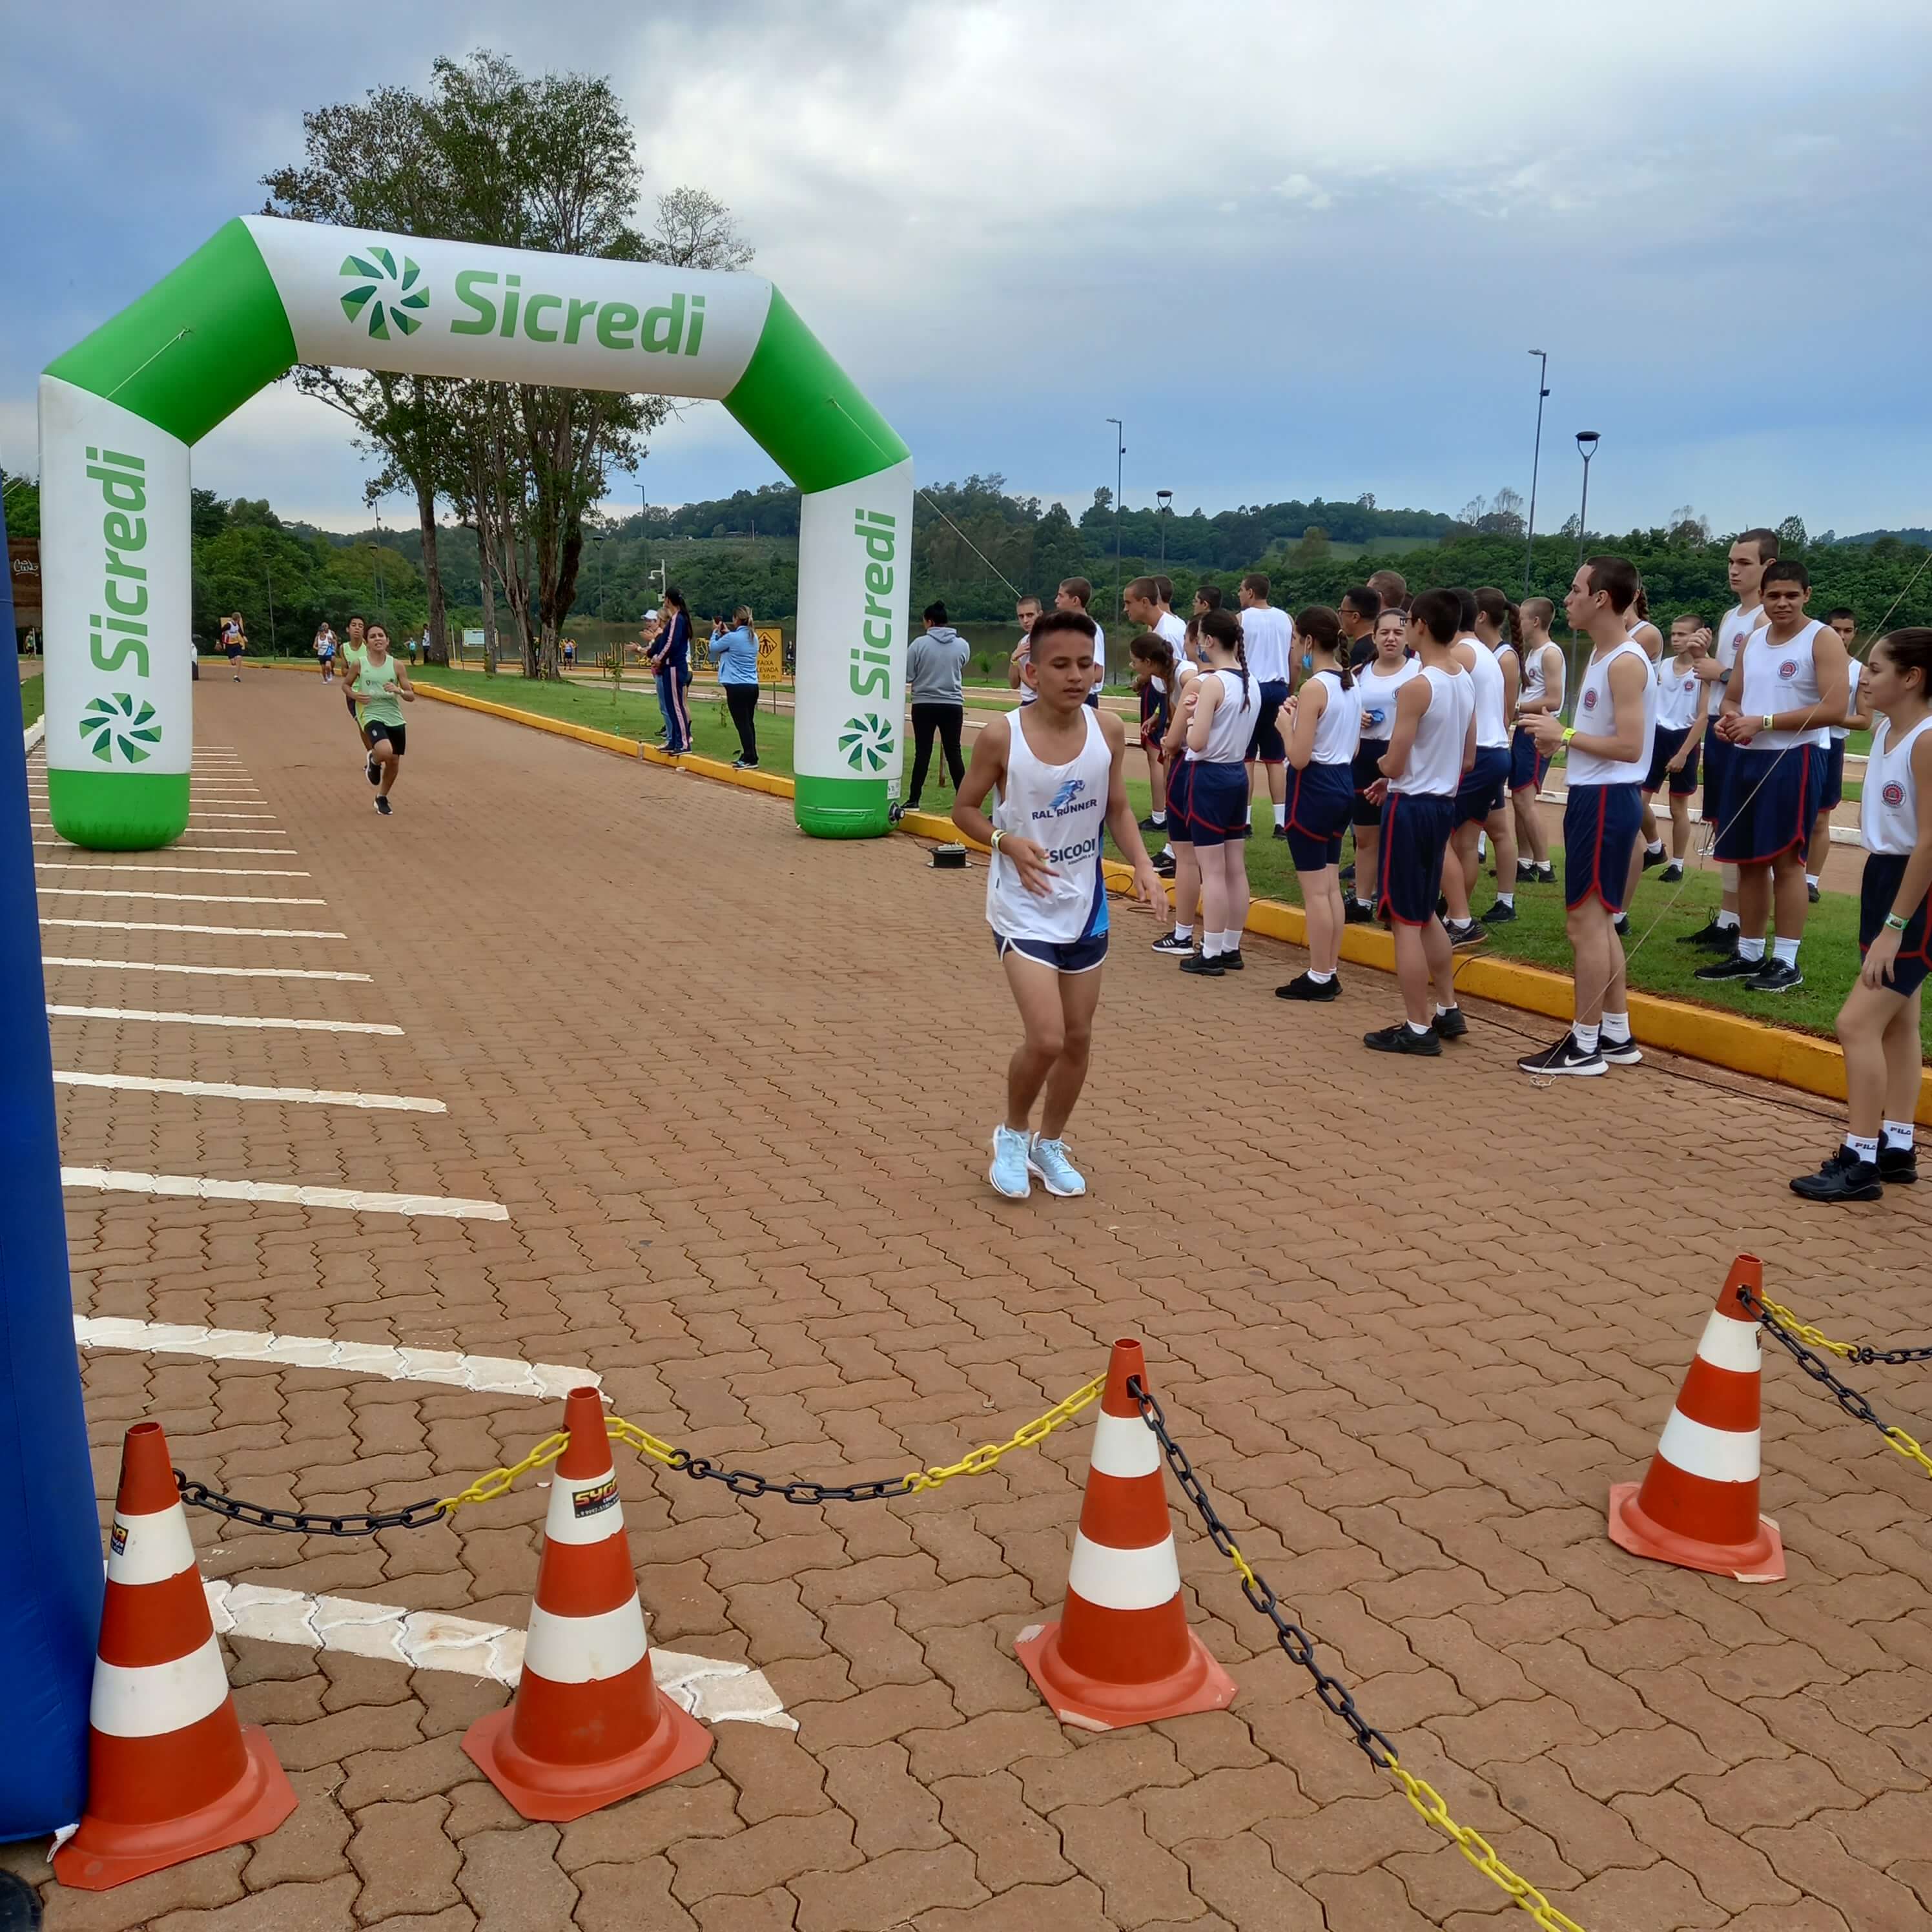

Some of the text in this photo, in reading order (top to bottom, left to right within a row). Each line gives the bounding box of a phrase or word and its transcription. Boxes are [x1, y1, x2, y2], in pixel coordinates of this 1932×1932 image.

[450, 270, 705, 356] Sicredi
[85, 446, 149, 678] Sicredi
[850, 508, 896, 700] Sicredi
[1032, 799, 1097, 820] RAL RUNNER
